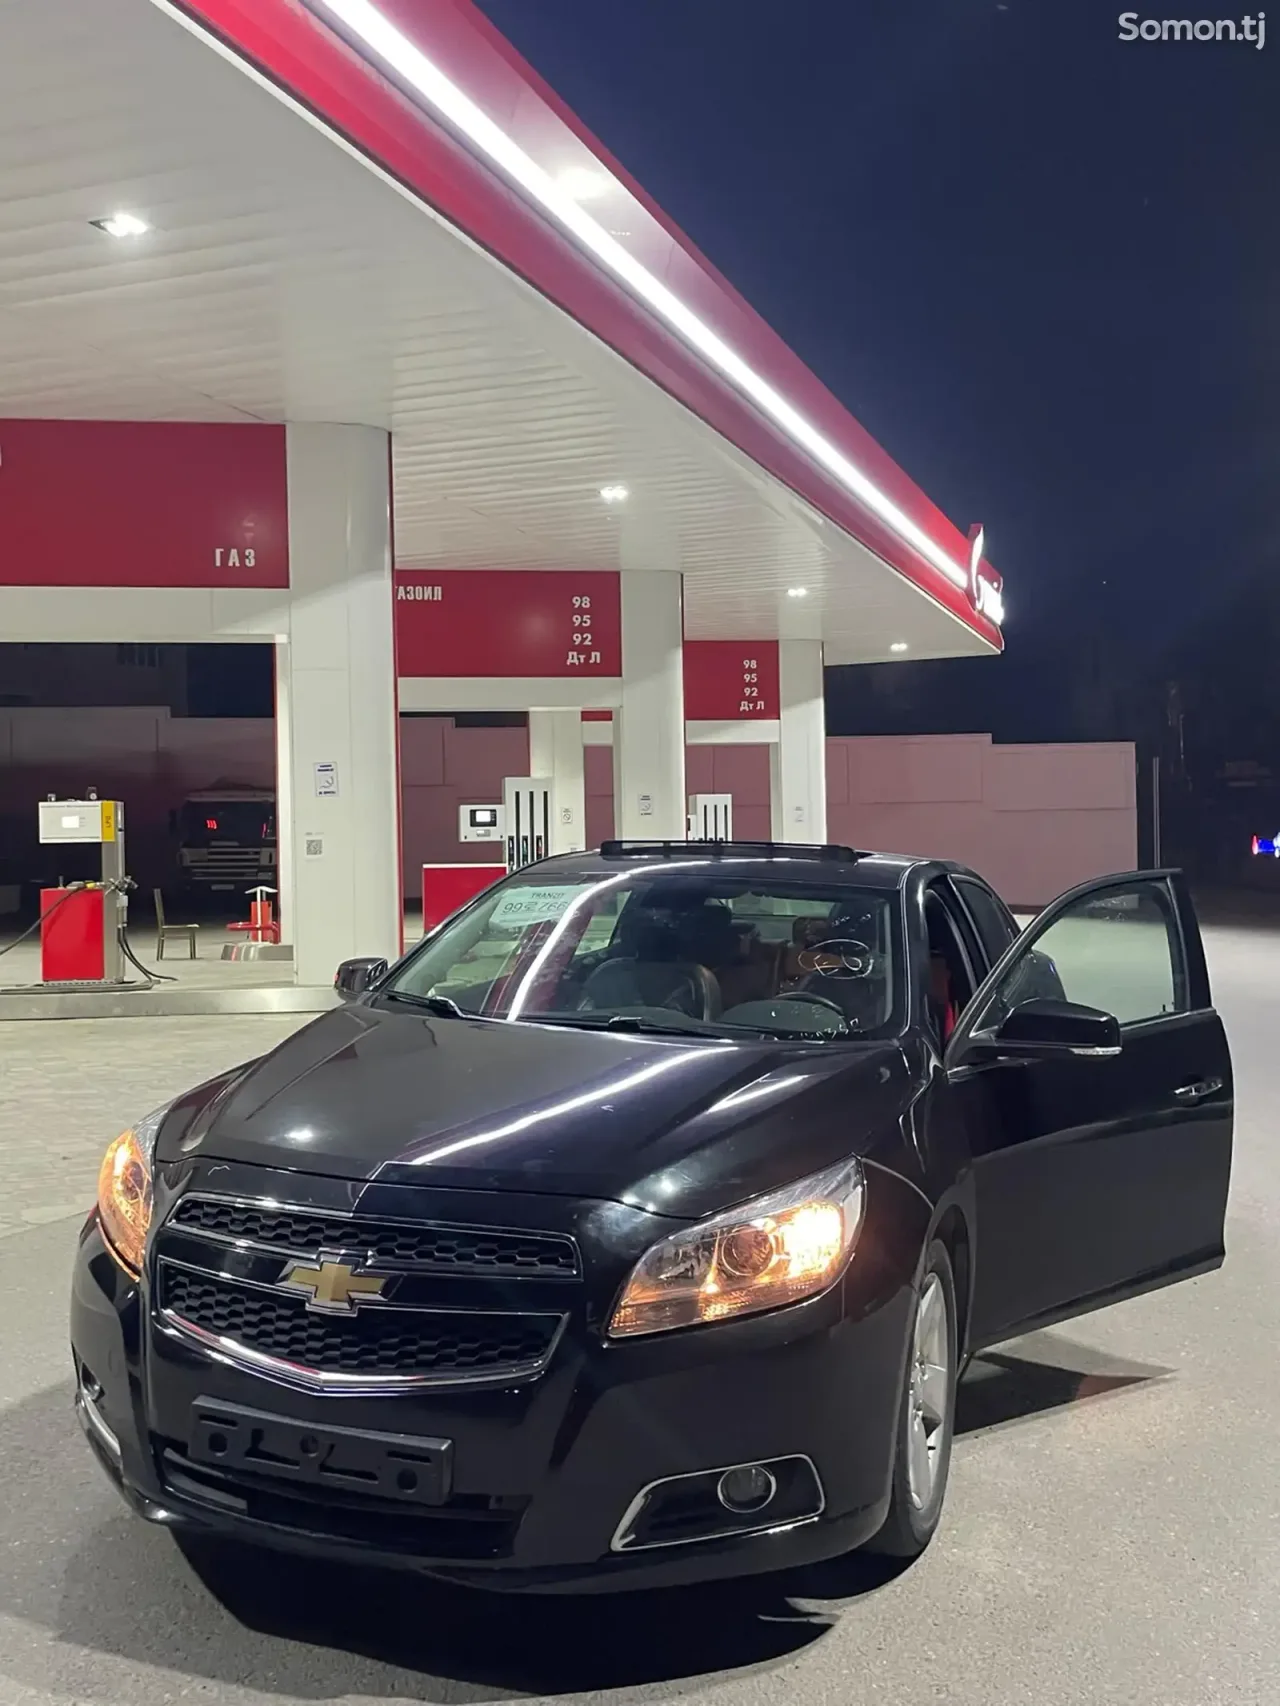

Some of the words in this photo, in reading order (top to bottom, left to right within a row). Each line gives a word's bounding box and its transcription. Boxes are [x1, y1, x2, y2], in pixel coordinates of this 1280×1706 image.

[214, 547, 256, 567] ГАЗ
[395, 585, 442, 601] АЗОИЛ
[572, 596, 591, 609] 98
[572, 614, 591, 627] 95
[572, 633, 592, 645] 92
[566, 651, 586, 666] Дт
[589, 651, 601, 664] Л
[743, 659, 757, 669] 98
[743, 673, 757, 683] 95
[743, 687, 758, 697] 92
[739, 701, 754, 712] Дт
[755, 701, 765, 710] Л
